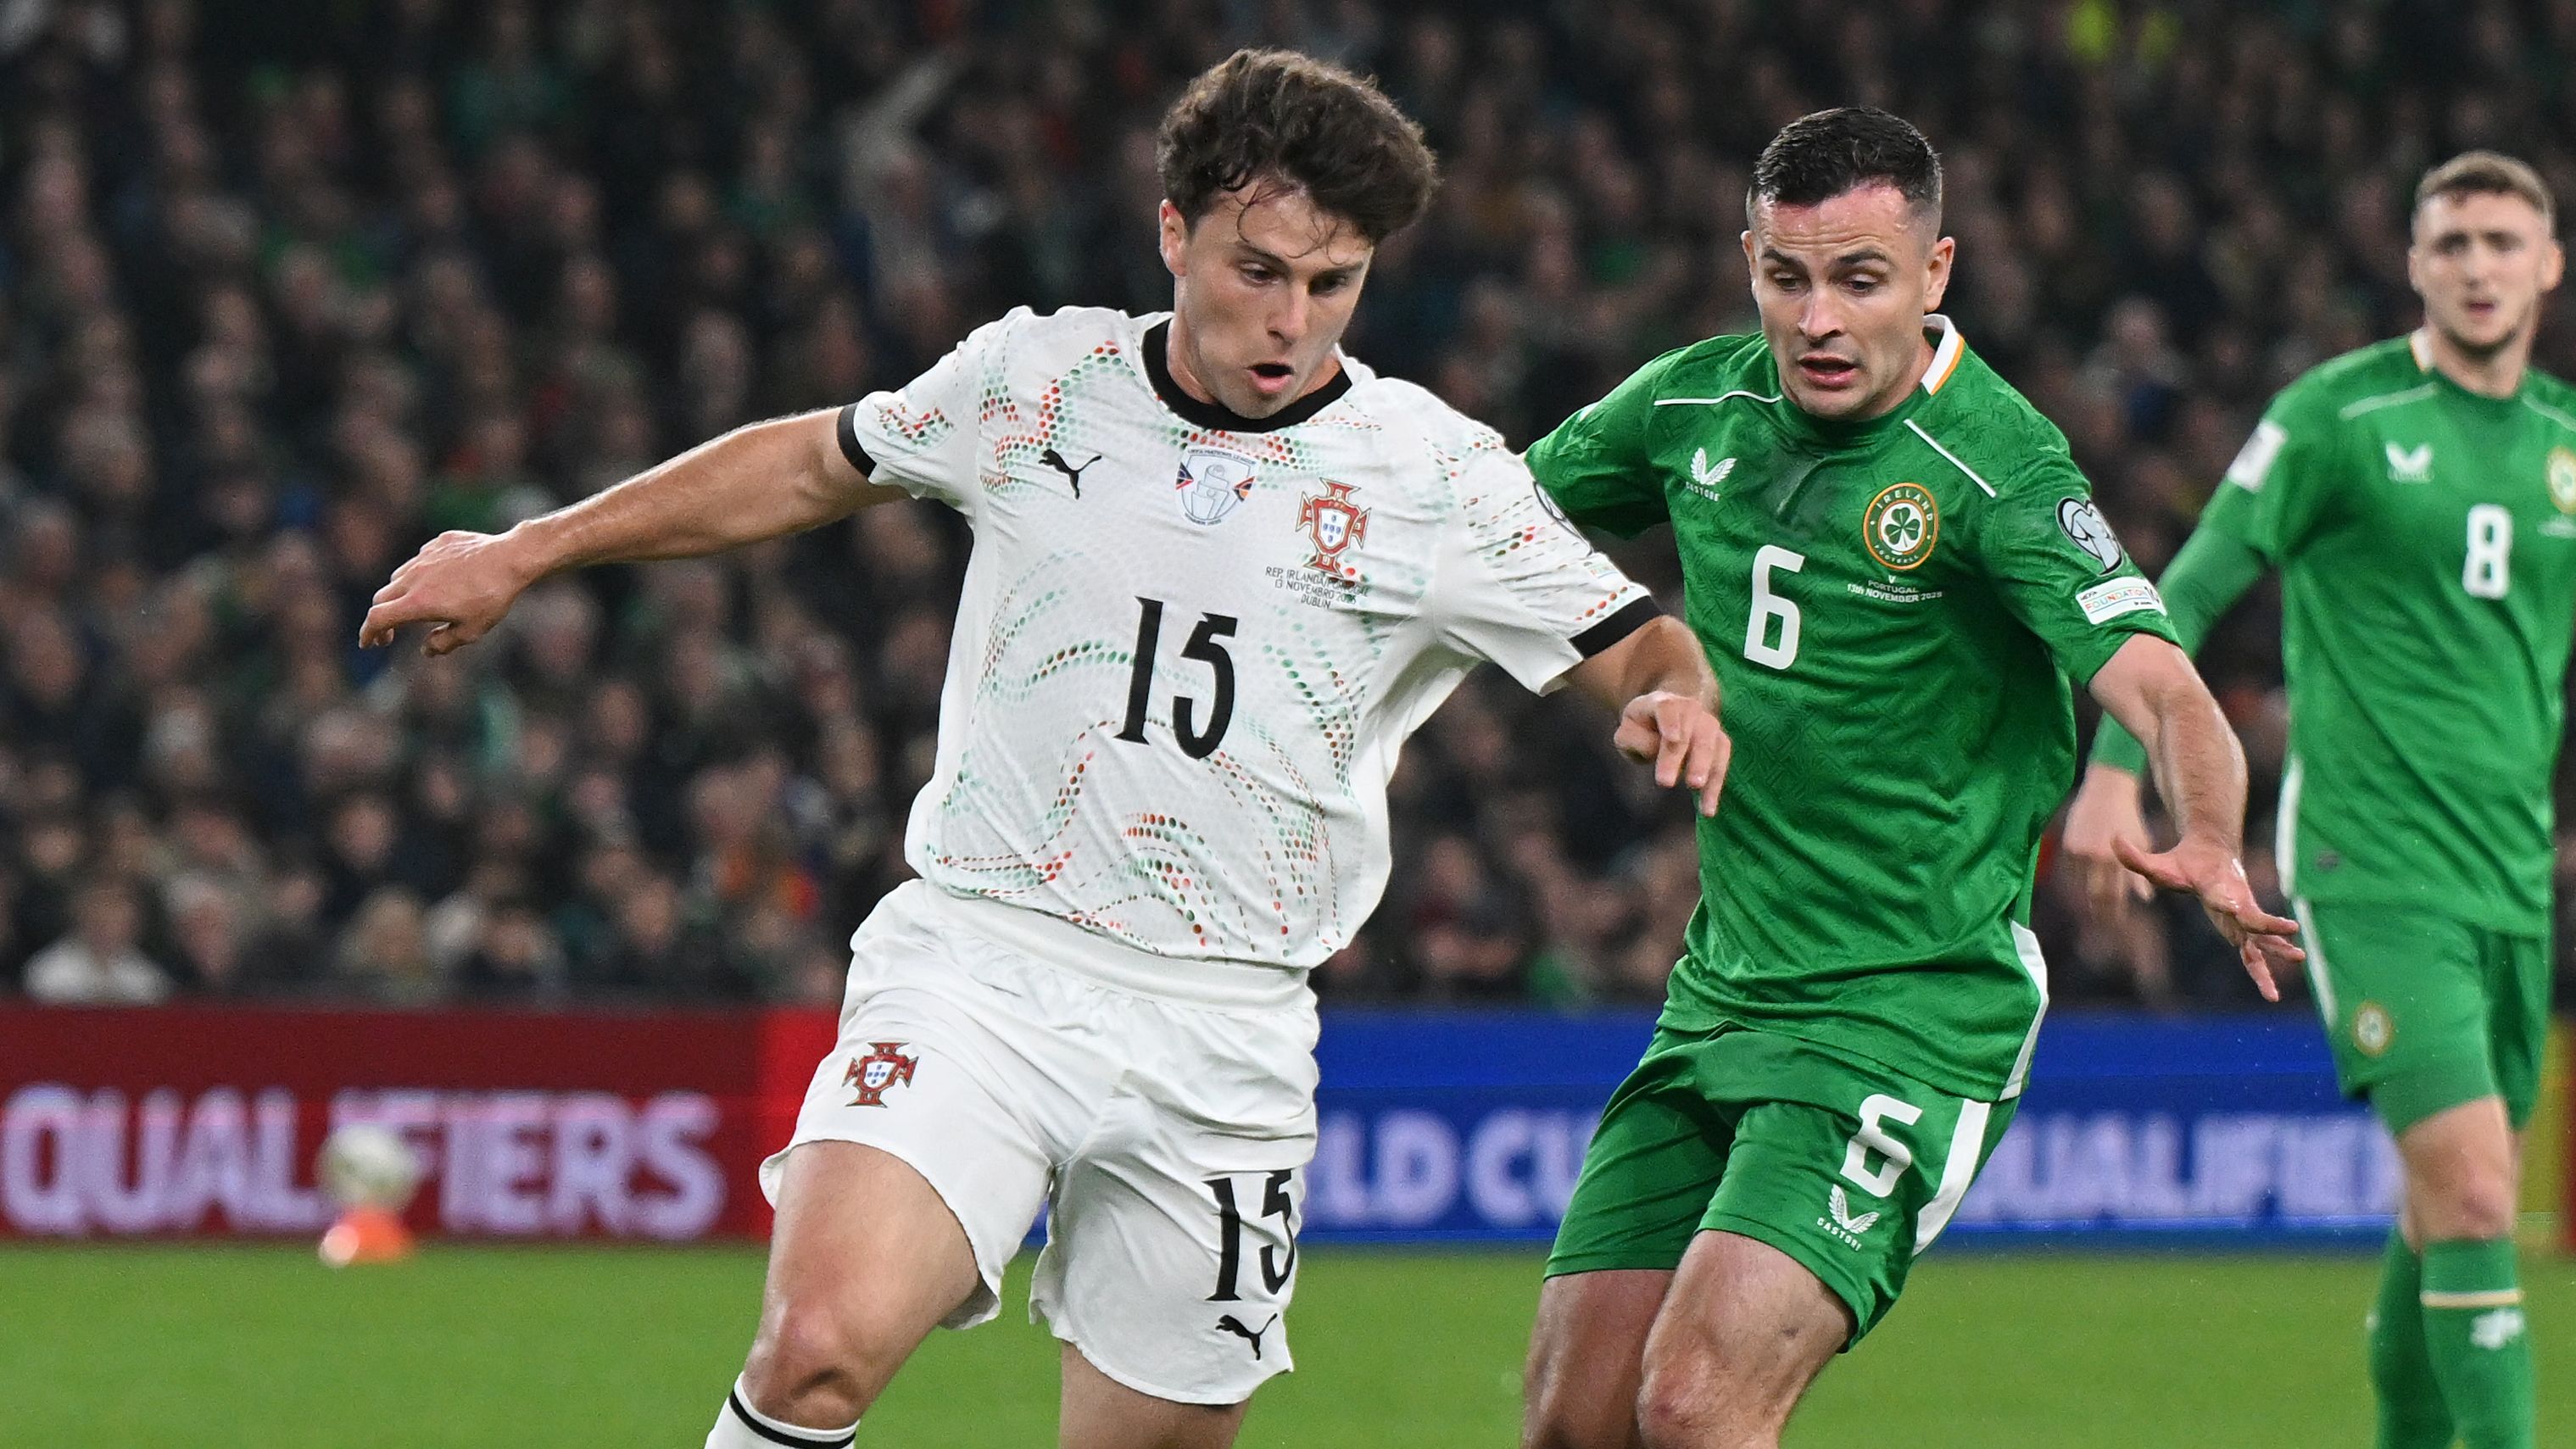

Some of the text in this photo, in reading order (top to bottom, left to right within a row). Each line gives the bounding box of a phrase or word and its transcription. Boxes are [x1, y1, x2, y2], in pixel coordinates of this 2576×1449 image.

[1876, 489, 1934, 521] IRELAND
[2462, 503, 2514, 600] 8
[1274, 578, 1283, 588] 13
[1285, 580, 1335, 599] NOVEMBRO
[1300, 594, 1331, 610] DUBLIN
[1743, 543, 1806, 671] 6
[1865, 588, 1920, 603] NOVEMBER
[1868, 579, 1920, 594] PORTUGAL
[1112, 595, 1238, 761] 15
[1838, 1093, 1923, 1198] 6
[1201, 1168, 1295, 1301] 15
